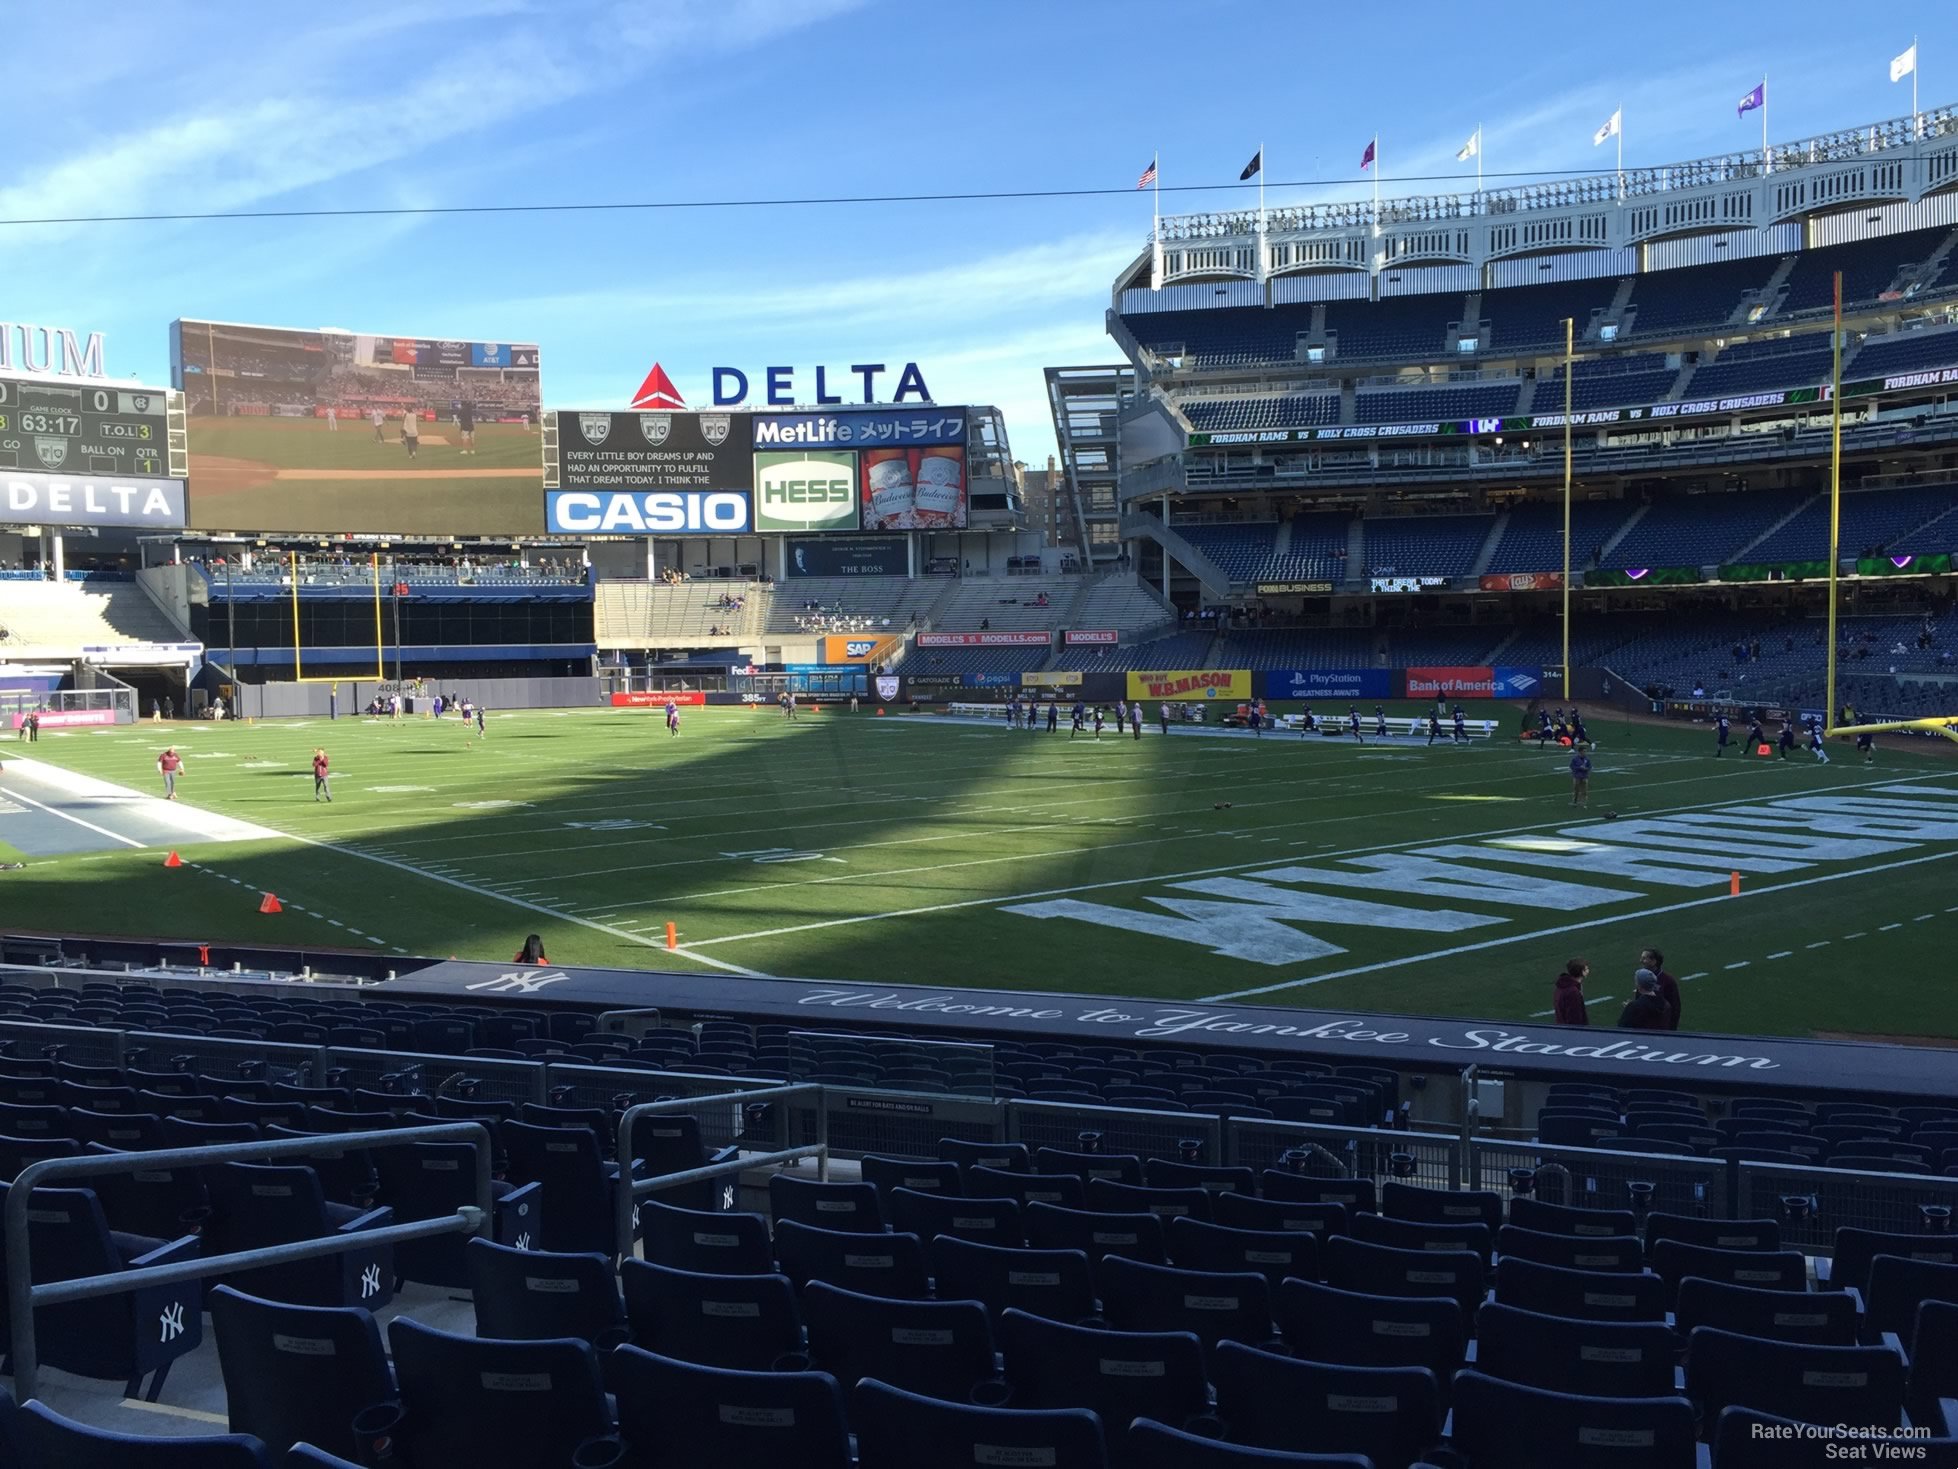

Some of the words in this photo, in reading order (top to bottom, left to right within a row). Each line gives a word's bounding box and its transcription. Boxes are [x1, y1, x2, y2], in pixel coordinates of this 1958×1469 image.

[482, 356, 500, 364] AT&T
[711, 361, 933, 407] DELTA
[1883, 371, 1940, 391] FORDHAM
[93, 390, 109, 412] 0
[30, 405, 50, 413] GAME
[50, 407, 72, 415] CLOCK
[1586, 410, 1620, 425] RAMS
[1651, 405, 1680, 418] HOLY
[1680, 401, 1718, 415] CROSS
[1719, 393, 1785, 411] CRUSADERS
[22, 414, 79, 434] 63:17
[139, 424, 150, 439] 3
[755, 417, 853, 444] MetLife
[859, 417, 964, 441] メットライフ
[1210, 432, 1258, 444] FORDHAM
[1258, 430, 1289, 442] RAMS
[1317, 428, 1343, 440] HOLY
[1343, 427, 1377, 438] CROSS
[1378, 423, 1440, 436] CRUSADERS
[3, 440, 21, 449] GO
[81, 445, 106, 455] BALL
[108, 446, 125, 456] ON
[136, 447, 158, 458] QTR
[567, 452, 595, 460] EVERY
[596, 452, 625, 461] LITTLE
[627, 452, 644, 461] BOY
[647, 452, 681, 461] DREAMS
[683, 452, 695, 461] UP
[697, 452, 715, 461] AND
[143, 460, 152, 473] 1
[567, 464, 586, 473] HAD
[588, 464, 600, 473] AN
[602, 464, 662, 473] OPPORTUNITY
[663, 464, 676, 473] TO
[678, 464, 710, 473] FULFILL
[568, 475, 590, 484] THAT
[593, 475, 623, 484] DREAM
[624, 475, 656, 484] TODAY.
[658, 475, 663, 485] I
[664, 476, 691, 485] THINK
[692, 476, 710, 485] THE
[764, 479, 850, 504] HESS
[8, 480, 172, 516] DELTA
[556, 493, 747, 531] CASIO
[840, 565, 859, 574] THE
[861, 564, 884, 574] BOSS
[1370, 579, 1389, 587] THAT
[1393, 578, 1416, 587] DREAM
[1420, 577, 1447, 586] TODAY.
[1370, 585, 1377, 593] I
[1380, 585, 1403, 593] THINK
[1407, 584, 1421, 592] THE
[922, 634, 964, 645] MODELL'S
[981, 633, 1047, 644] MODELLS.com
[1070, 632, 1113, 642] MODELL'S
[847, 643, 873, 656] SAP
[731, 665, 760, 676] FedEx
[985, 674, 1011, 684] pepsi
[1310, 673, 1361, 686] PlayStation
[1409, 679, 1441, 692] Bank
[1441, 679, 1454, 692] of
[1455, 679, 1505, 691] America
[1292, 689, 1333, 697] GREATNESS
[1332, 689, 1360, 697] AWAITS
[797, 988, 1064, 1020] Welcome
[1076, 1006, 1146, 1024] to
[1134, 1008, 1410, 1044] Yankee
[1428, 1027, 1783, 1070] Stadium
